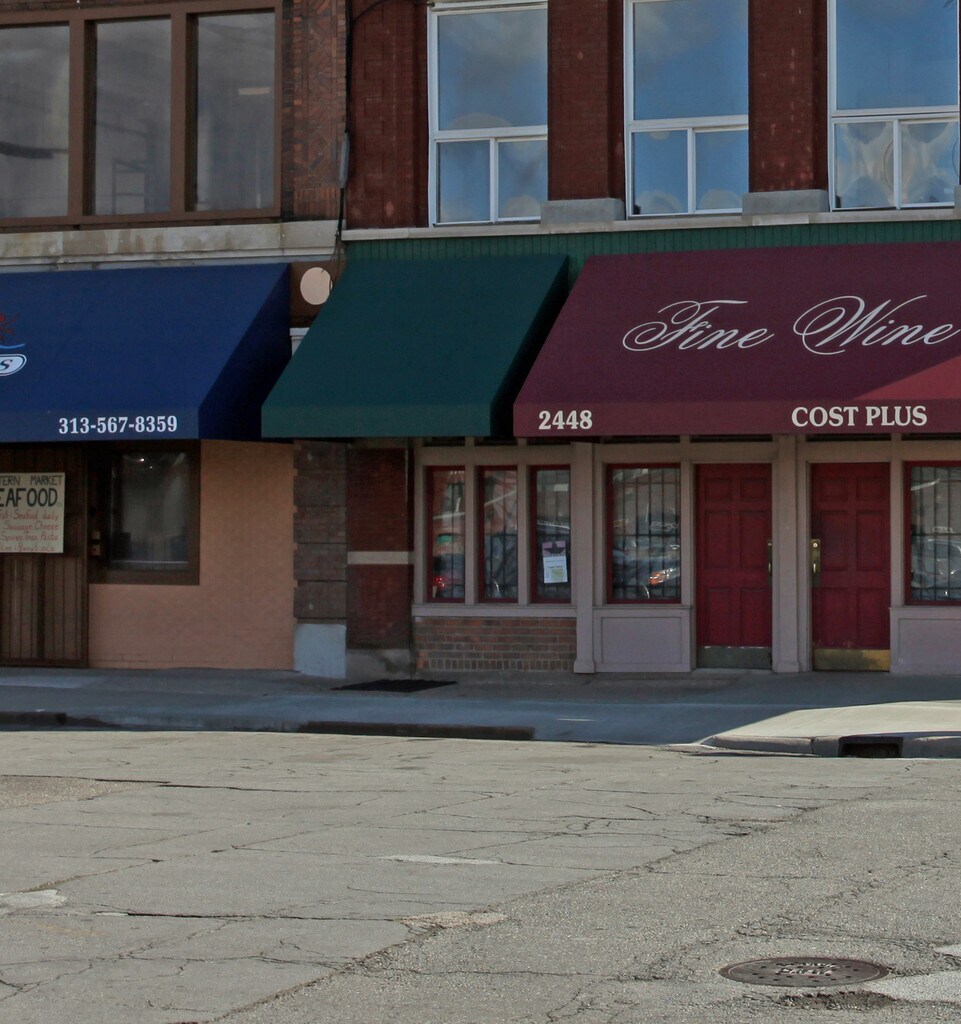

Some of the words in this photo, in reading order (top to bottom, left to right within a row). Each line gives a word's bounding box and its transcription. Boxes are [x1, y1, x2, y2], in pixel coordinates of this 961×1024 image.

[622, 299, 775, 352] Fine
[792, 294, 961, 355] Wine
[58, 415, 178, 435] 313-567-8359
[538, 409, 593, 430] 2448
[791, 406, 859, 427] COST
[865, 405, 928, 427] PLUS
[30, 475, 63, 486] MARKET
